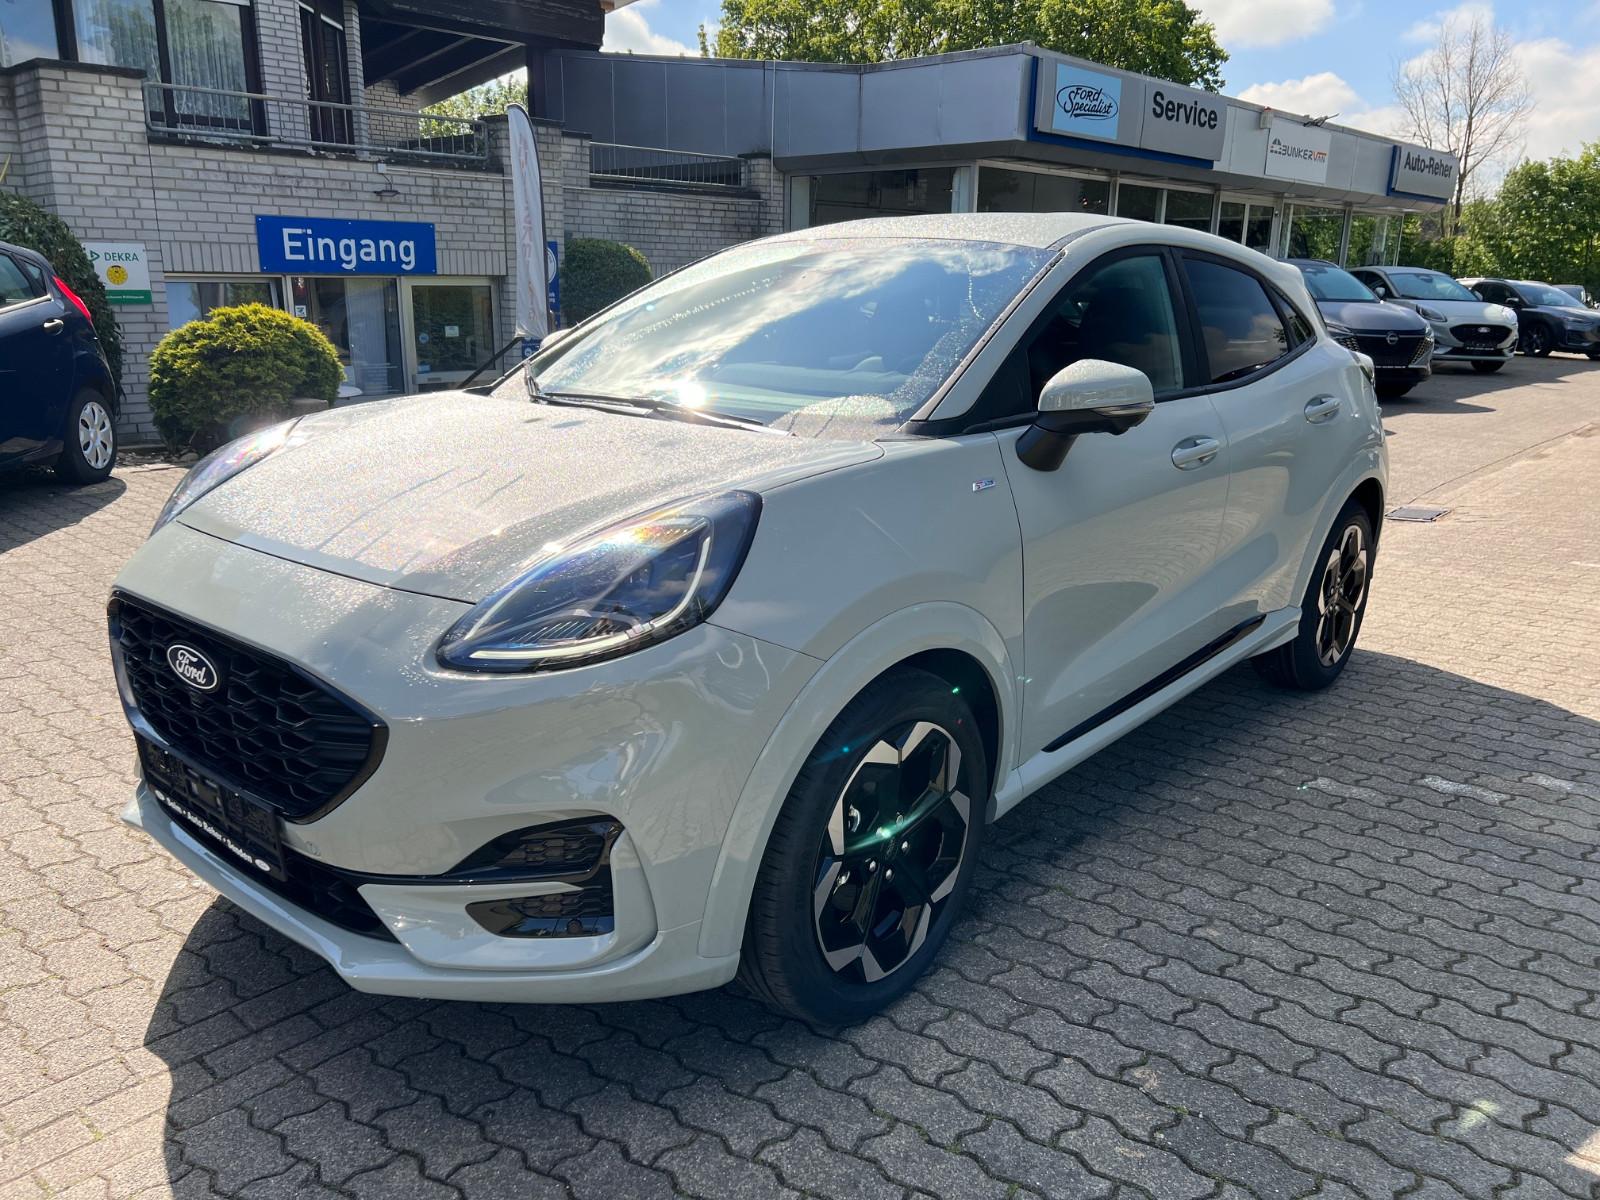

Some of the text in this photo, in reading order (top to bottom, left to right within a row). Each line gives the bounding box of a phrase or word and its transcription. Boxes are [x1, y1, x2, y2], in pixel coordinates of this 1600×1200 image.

[1063, 90, 1113, 119] Specialist
[1152, 91, 1218, 130] Service
[1404, 151, 1453, 178] Auto-Reher
[104, 252, 140, 262] DEKRA
[282, 227, 416, 271] Eingang
[176, 649, 207, 684] Ford
